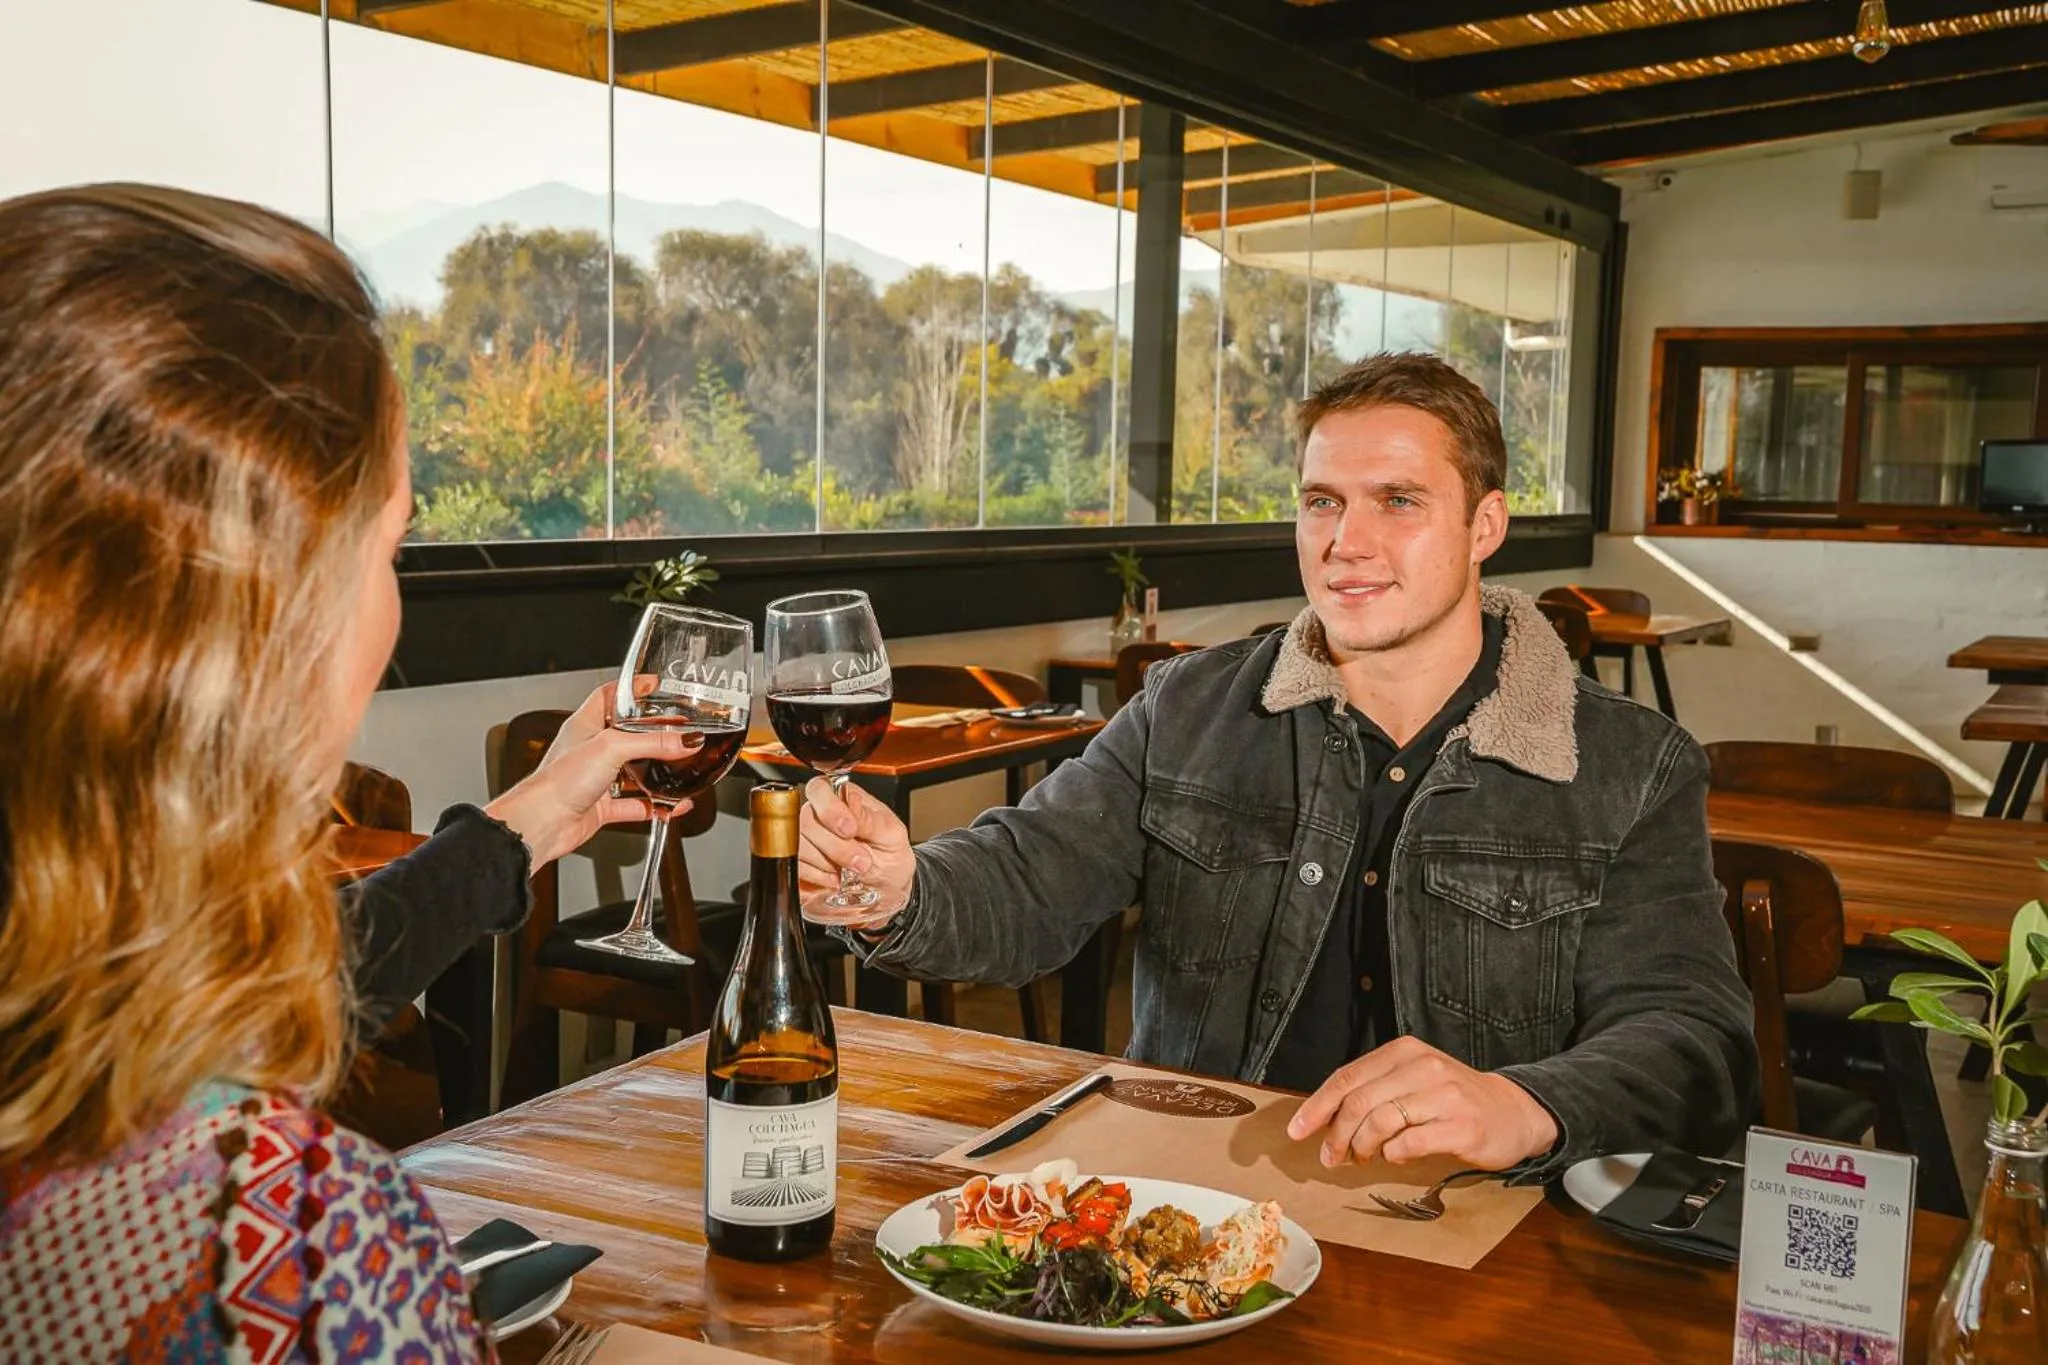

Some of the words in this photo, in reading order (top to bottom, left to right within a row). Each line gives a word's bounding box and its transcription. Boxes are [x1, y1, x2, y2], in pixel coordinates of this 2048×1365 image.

[667, 659, 730, 689] CAVA
[832, 651, 882, 679] CAVA
[1791, 1147, 1832, 1169] CAVA
[1750, 1179, 1786, 1196] CARTA
[1791, 1186, 1865, 1210] RESTAURANT
[1879, 1203, 1901, 1217] SPA
[1800, 1279, 1821, 1292] SCAN
